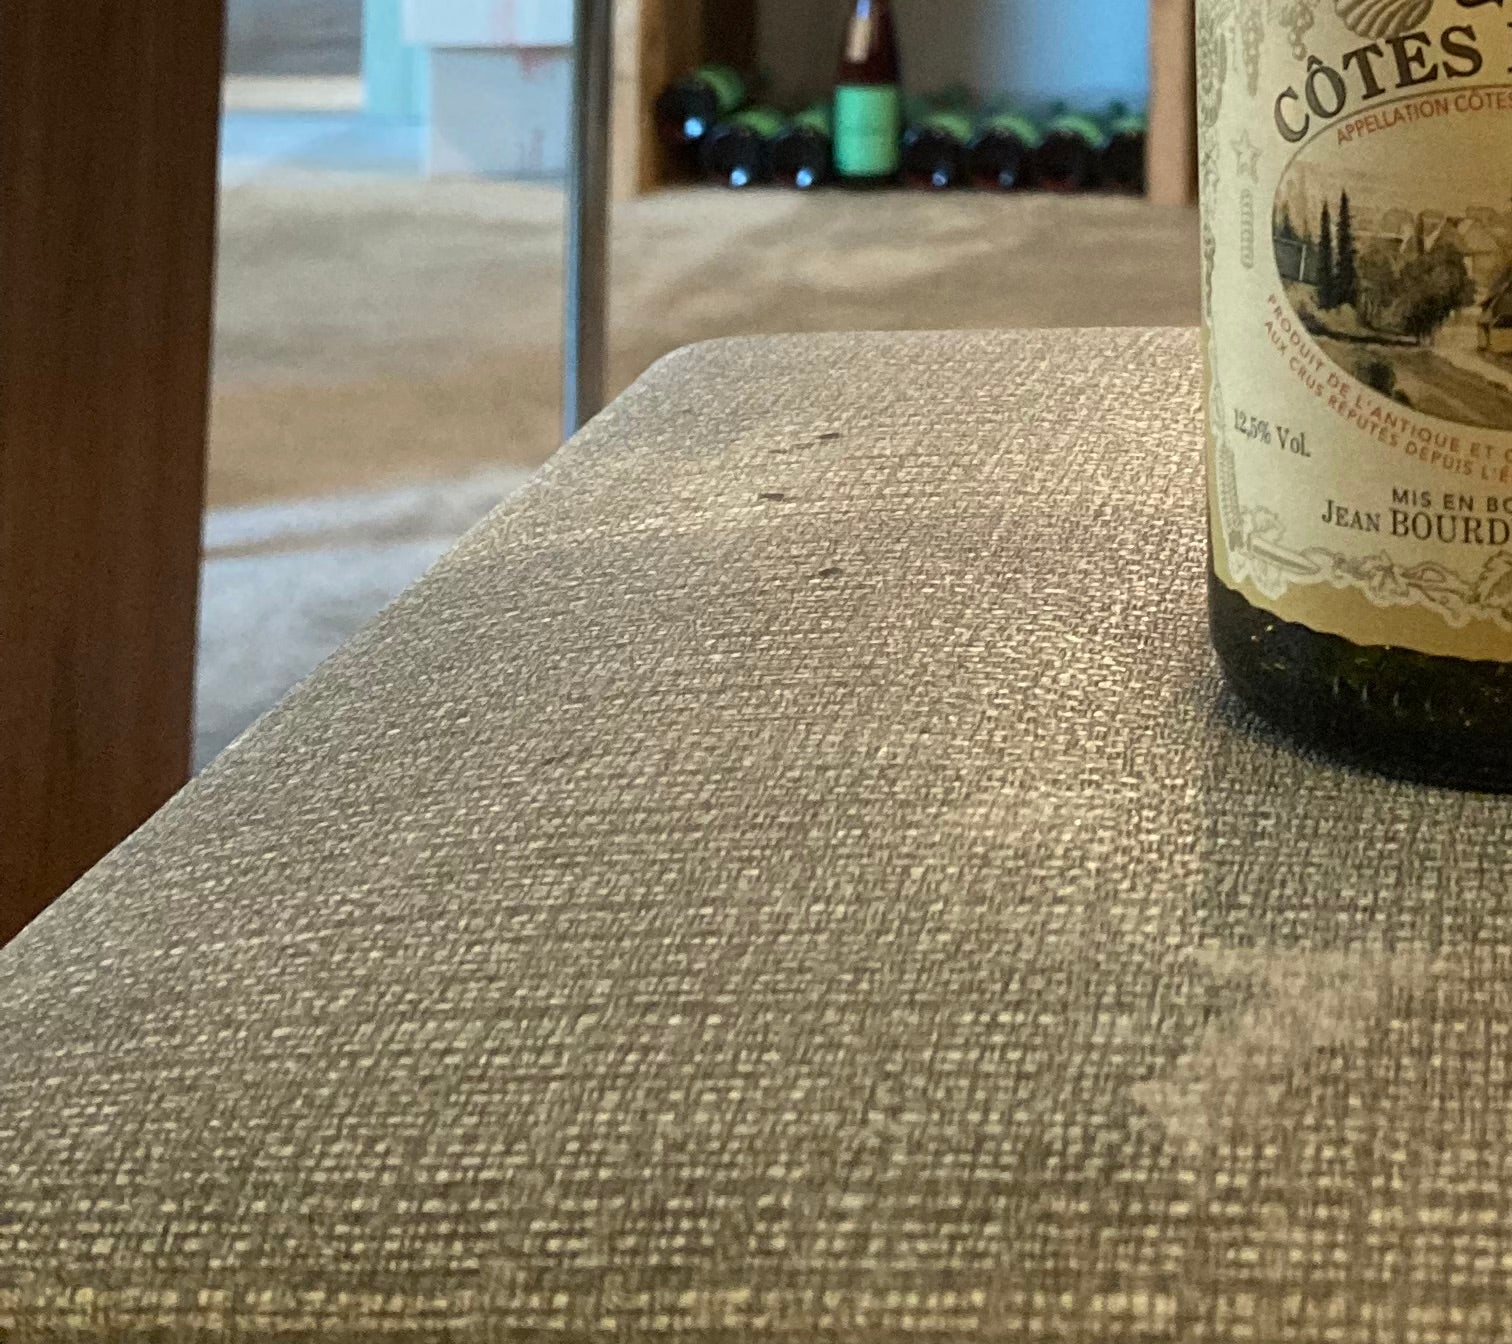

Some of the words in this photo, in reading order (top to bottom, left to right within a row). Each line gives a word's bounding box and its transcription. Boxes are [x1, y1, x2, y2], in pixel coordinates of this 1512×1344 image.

[1274, 24, 1483, 143] CÔTES
[1337, 97, 1448, 145] APPELLATION
[1264, 320, 1287, 356] AUX
[1288, 356, 1325, 397] CRUS
[1405, 440, 1473, 476] DEPUIS
[1267, 294, 1326, 372] PRODUIT
[1326, 372, 1350, 396] DE
[1355, 394, 1460, 453] L'ANTIQUE
[1470, 443, 1495, 459] ET
[1234, 408, 1271, 444] 12,5%
[1392, 486, 1431, 508] MIS
[1443, 493, 1473, 512] EN
